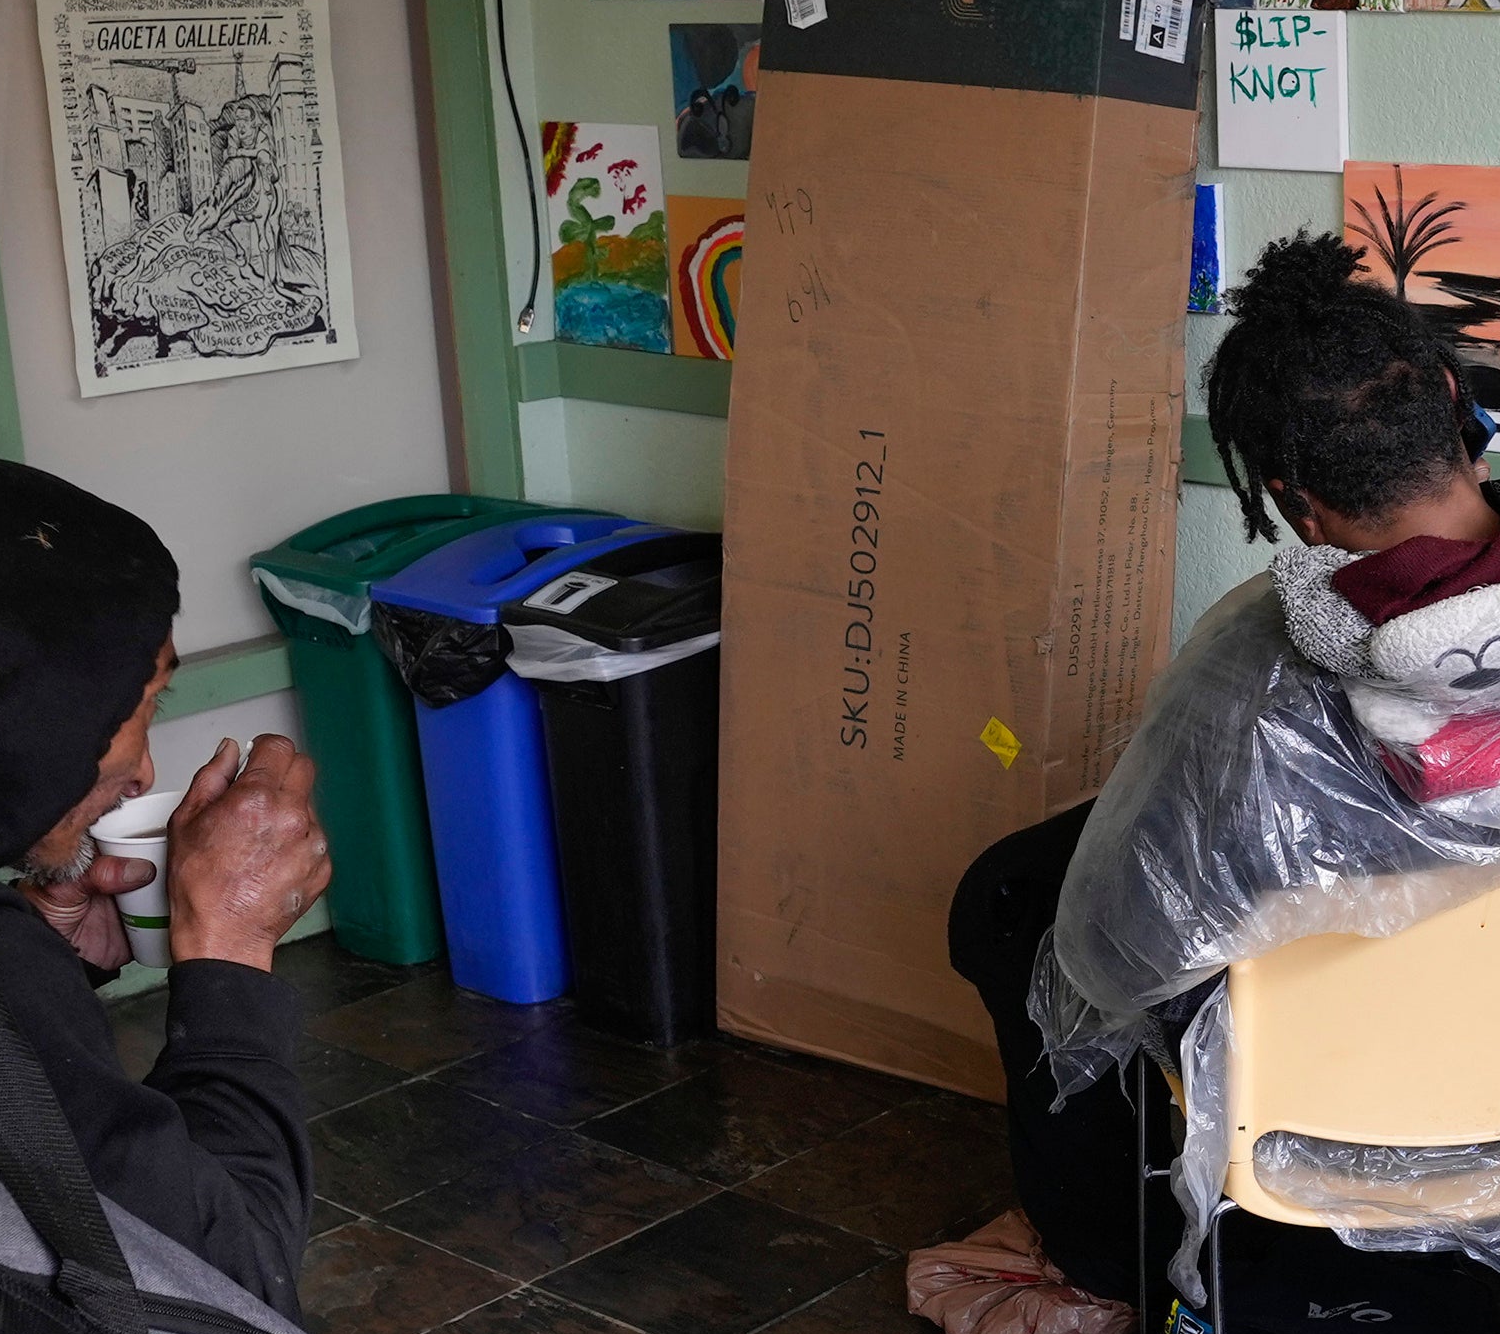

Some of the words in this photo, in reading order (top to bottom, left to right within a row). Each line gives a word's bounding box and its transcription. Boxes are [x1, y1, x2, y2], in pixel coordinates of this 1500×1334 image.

[1154, 6, 1162, 23] 120
[97, 26, 166, 51] GACETA
[175, 23, 272, 48] CALLEJERA.
[1152, 31, 1163, 44] A
[1230, 62, 1326, 108] KNOT
[144, 215, 191, 253] MATRIX
[191, 267, 234, 287] CARE
[204, 277, 239, 297] NOT
[219, 286, 263, 307] CASH
[159, 310, 205, 323] REFORM
[193, 330, 241, 346] NUISANCE
[246, 324, 280, 346] CRIME
[840, 428, 887, 750] SKU:DJ502912_1
[1066, 583, 1084, 677] DJ502912_1
[896, 631, 912, 684] CHINA
[896, 688, 908, 707] IN
[893, 712, 907, 762] MADE
